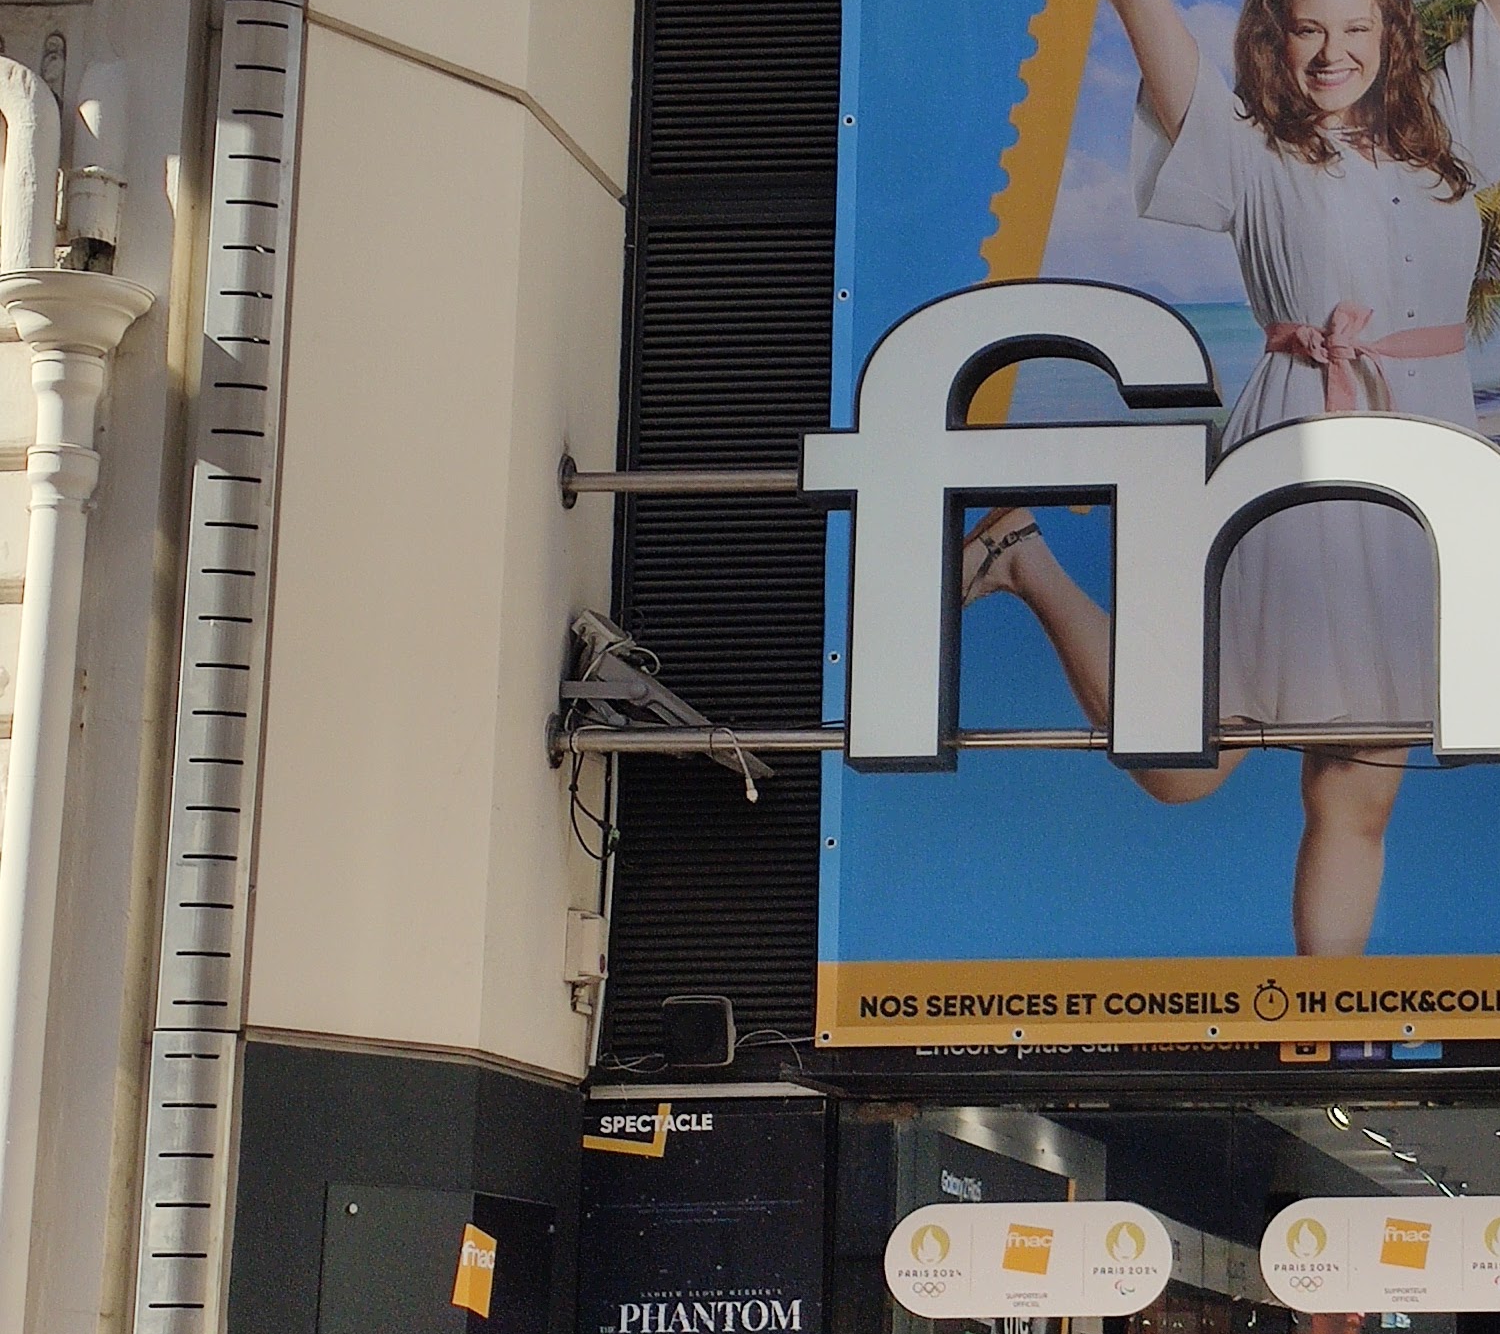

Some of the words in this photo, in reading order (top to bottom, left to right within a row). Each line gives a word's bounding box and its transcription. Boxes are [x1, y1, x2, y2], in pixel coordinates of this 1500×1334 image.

[859, 994, 918, 1018] NOS
[925, 992, 1058, 1018] SERVICES
[1064, 991, 1098, 1016] ET
[1103, 989, 1240, 1017] CONSEILS
[1296, 988, 1327, 1014] 1H
[600, 1113, 713, 1134] SPECTACLE
[1006, 1232, 1052, 1249] fnac
[1384, 1226, 1431, 1243] fnac
[461, 1240, 496, 1269] fnac
[898, 1269, 930, 1277] PARIS
[1093, 1267, 1126, 1275] PARIS
[1274, 1264, 1307, 1272] PARIS
[618, 1299, 802, 1334] PHANTOM
